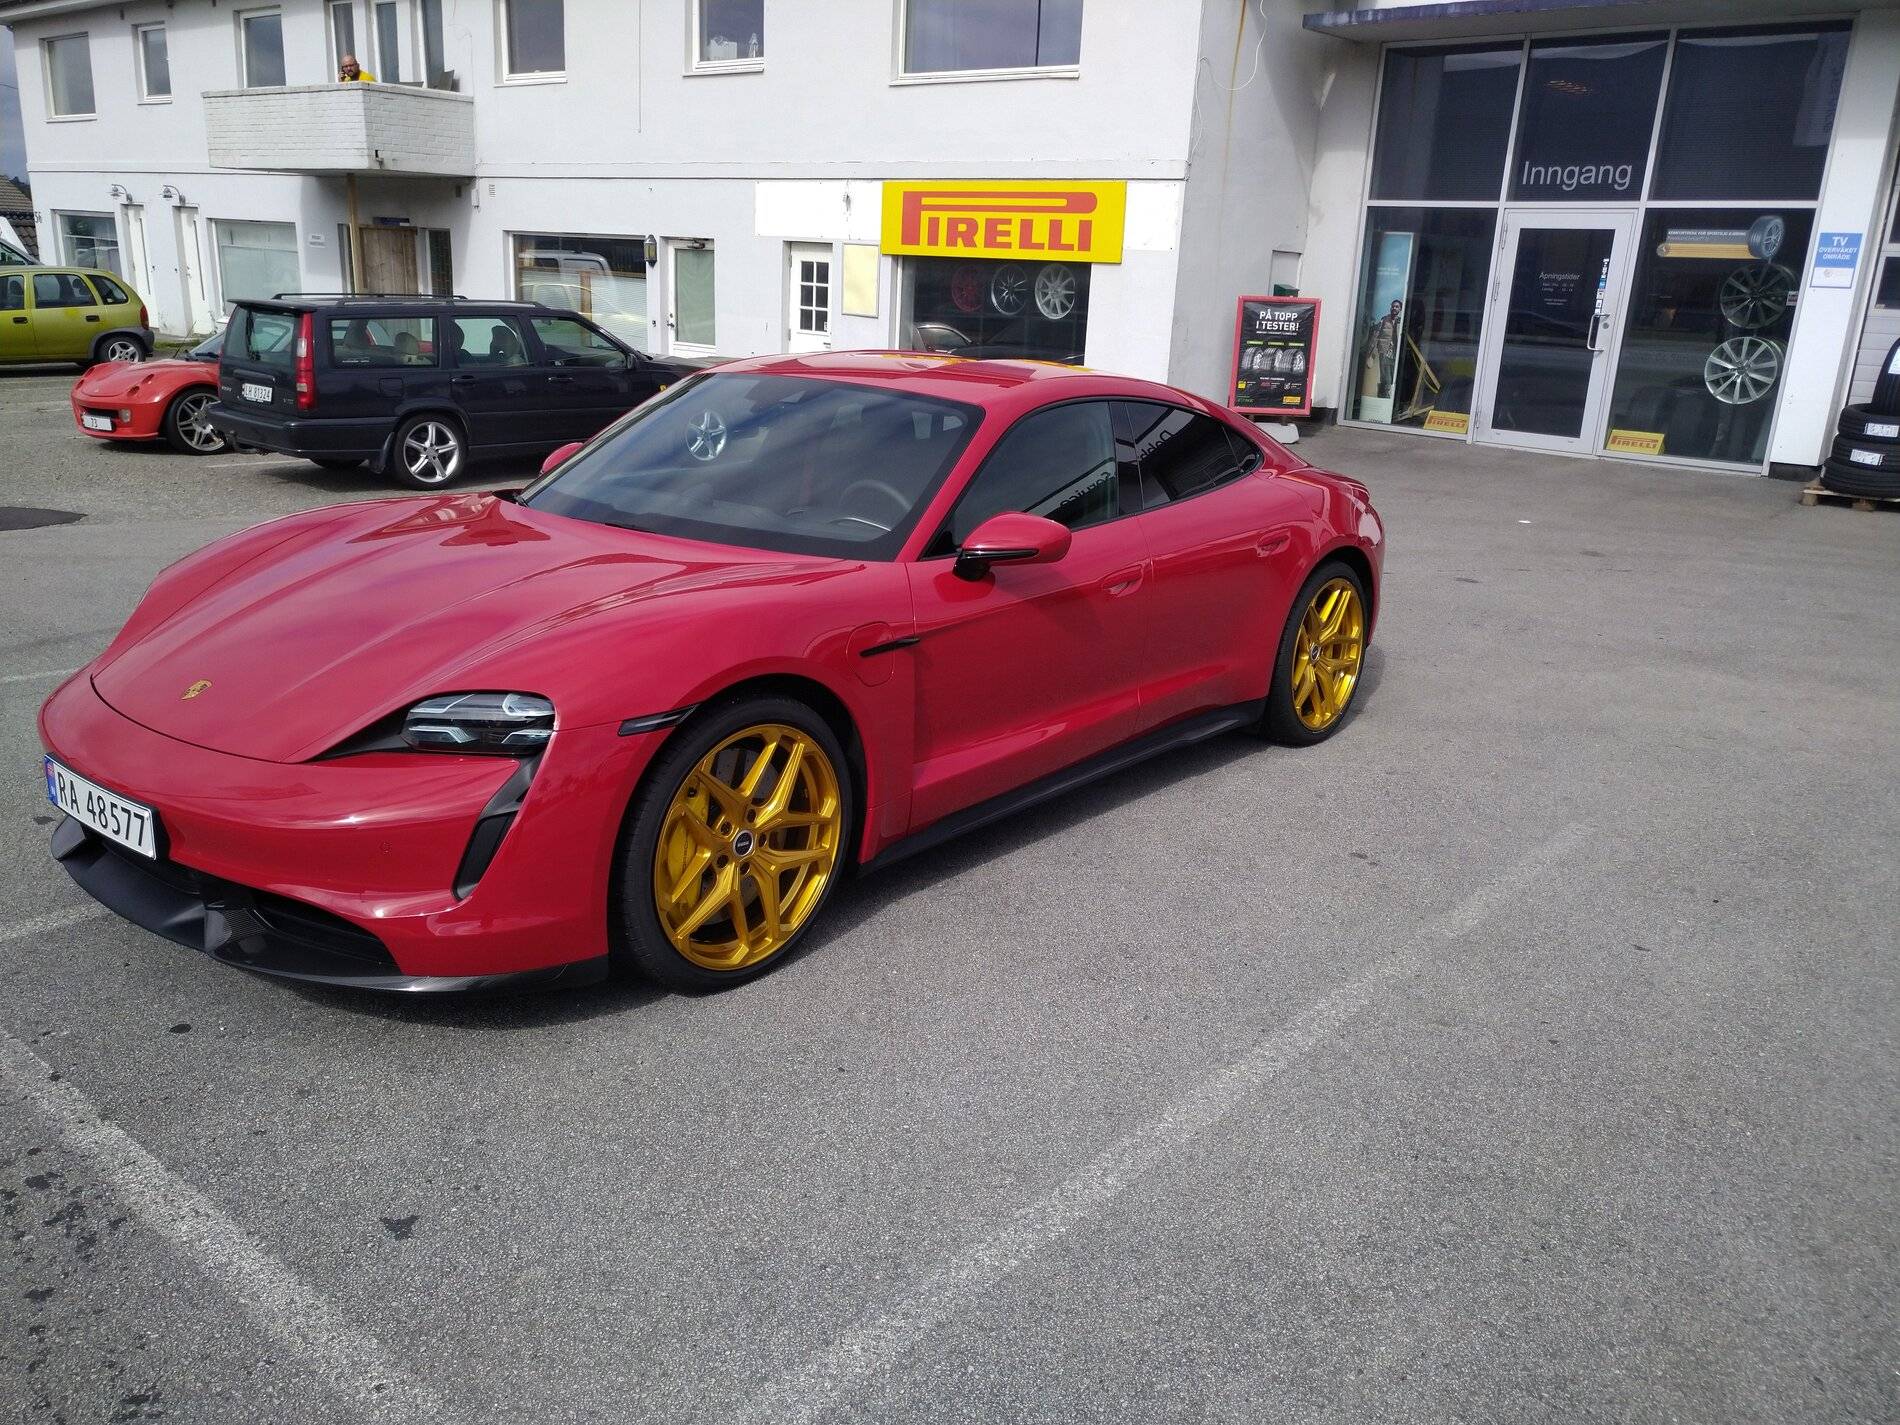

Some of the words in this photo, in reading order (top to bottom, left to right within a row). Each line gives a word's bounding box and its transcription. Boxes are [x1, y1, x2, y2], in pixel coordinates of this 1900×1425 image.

[1522, 161, 1632, 191] Inngang
[901, 190, 1098, 252] PIRELLI
[1832, 236, 1848, 246] TV
[1819, 247, 1857, 255] OVERVÅKET
[1539, 272, 1581, 281] Åpningstider
[1259, 308, 1273, 320] PÅ
[1274, 311, 1298, 321] TOPP
[1256, 321, 1260, 329] I
[1261, 321, 1300, 331] TESTER!
[1427, 415, 1467, 428] PIRELLI
[1610, 435, 1659, 448] PIRELLI
[57, 771, 80, 814] RA
[86, 790, 145, 847] 48577
